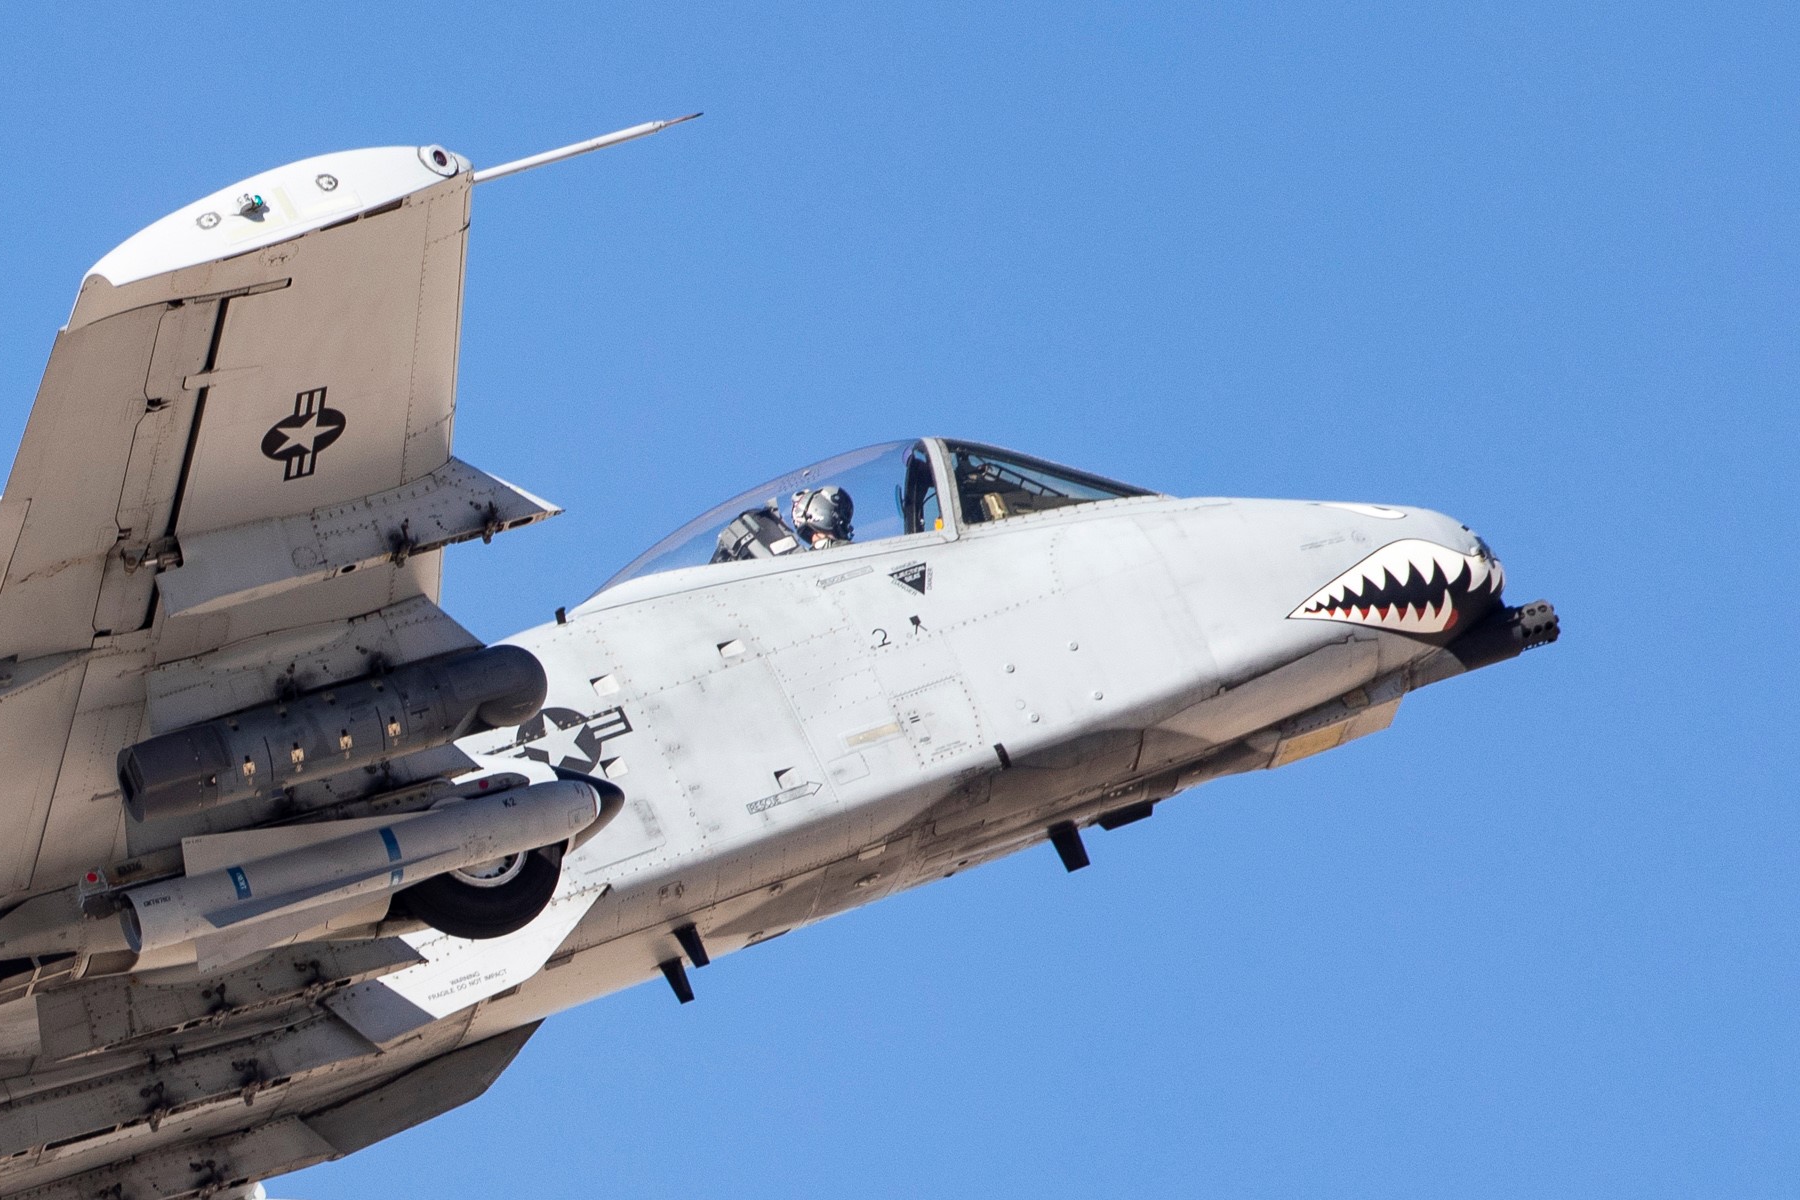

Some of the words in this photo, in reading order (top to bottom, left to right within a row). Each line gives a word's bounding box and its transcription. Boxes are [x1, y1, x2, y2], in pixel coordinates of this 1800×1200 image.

[891, 580, 918, 596] DANGER
[502, 796, 517, 808] K2
[748, 794, 781, 813] RESCUE
[428, 987, 456, 1001] FRAGILE
[456, 983, 467, 991] DO
[468, 977, 482, 987] NOT
[484, 968, 507, 981] IMPACT
[450, 970, 480, 985] WARNING
